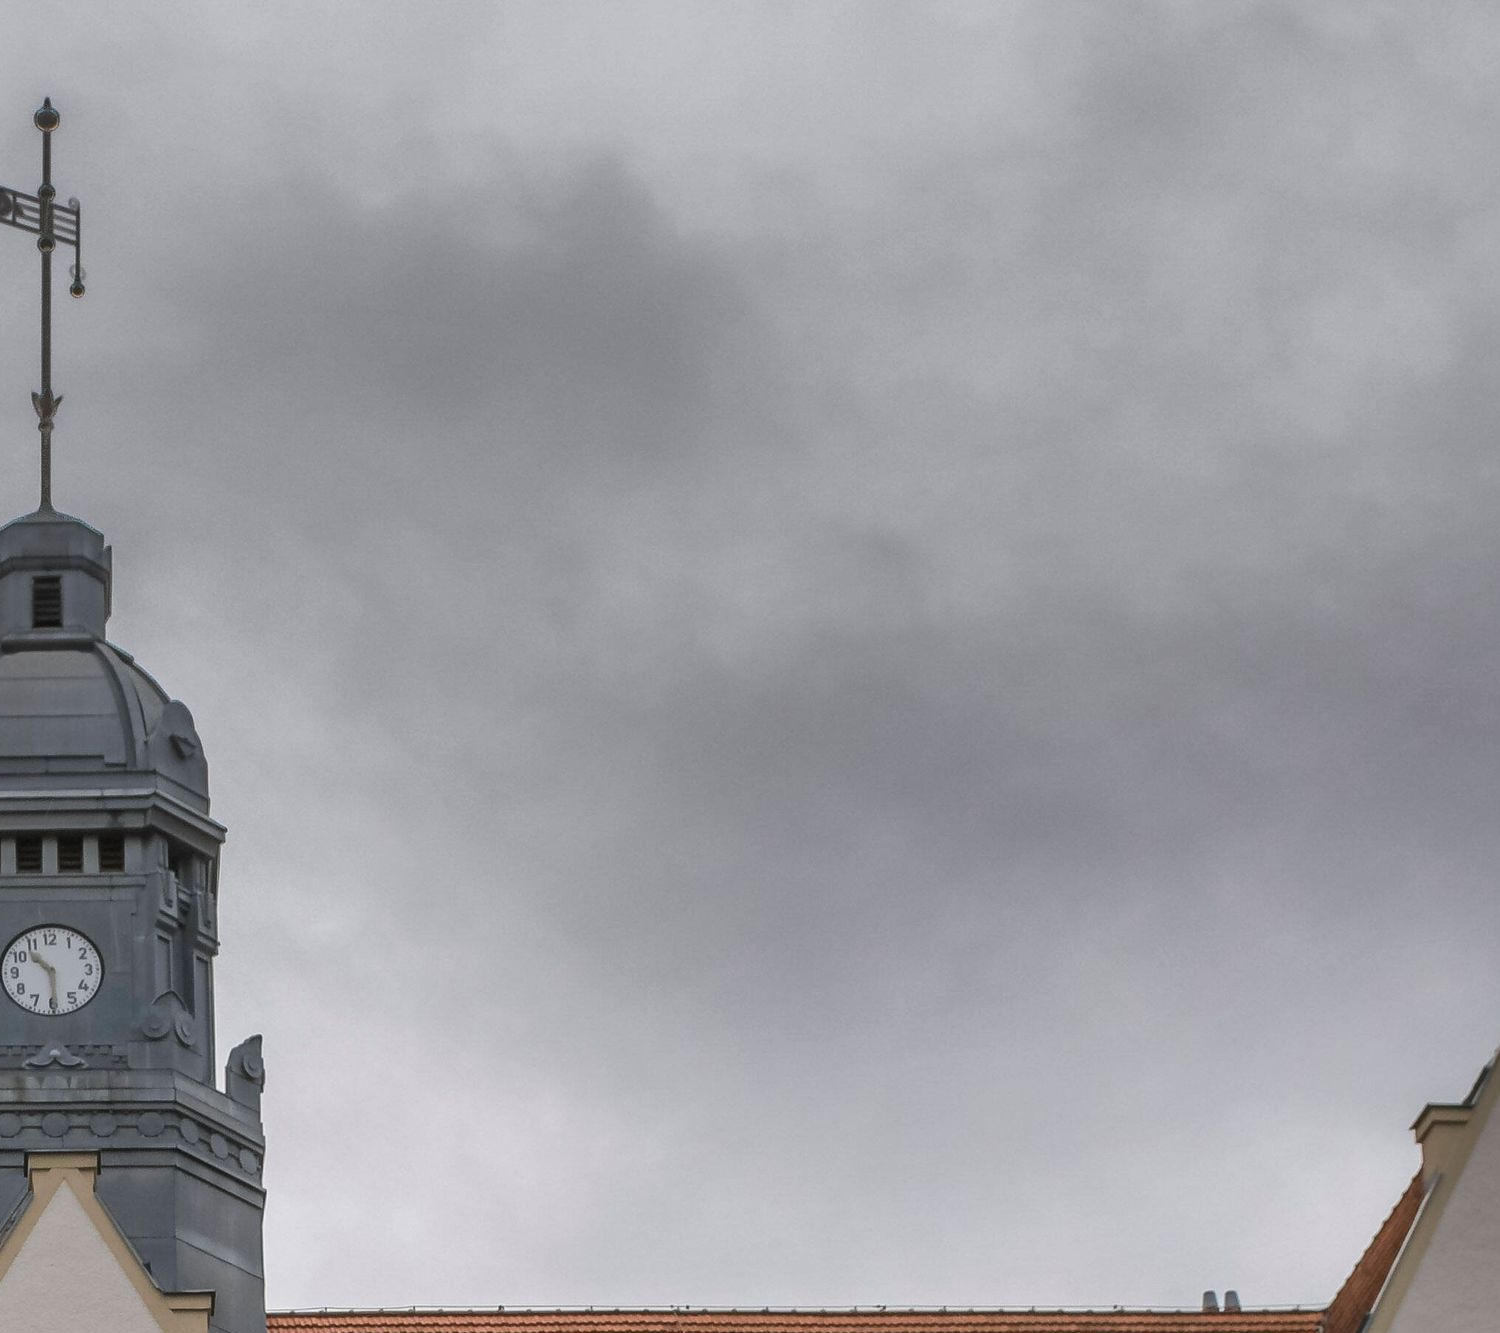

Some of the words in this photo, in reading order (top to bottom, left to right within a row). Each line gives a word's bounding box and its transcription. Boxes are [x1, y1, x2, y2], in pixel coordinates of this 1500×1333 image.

[27, 938, 37, 950] 11
[43, 933, 57, 945] 12
[66, 937, 71, 949] 1
[13, 951, 27, 963] 10
[79, 947, 87, 960] 2
[10, 966, 19, 979] 9
[84, 963, 93, 976] 3
[17, 983, 25, 995] 8
[78, 979, 89, 991] 4
[30, 994, 39, 1007] 7
[67, 992, 77, 1004] 5
